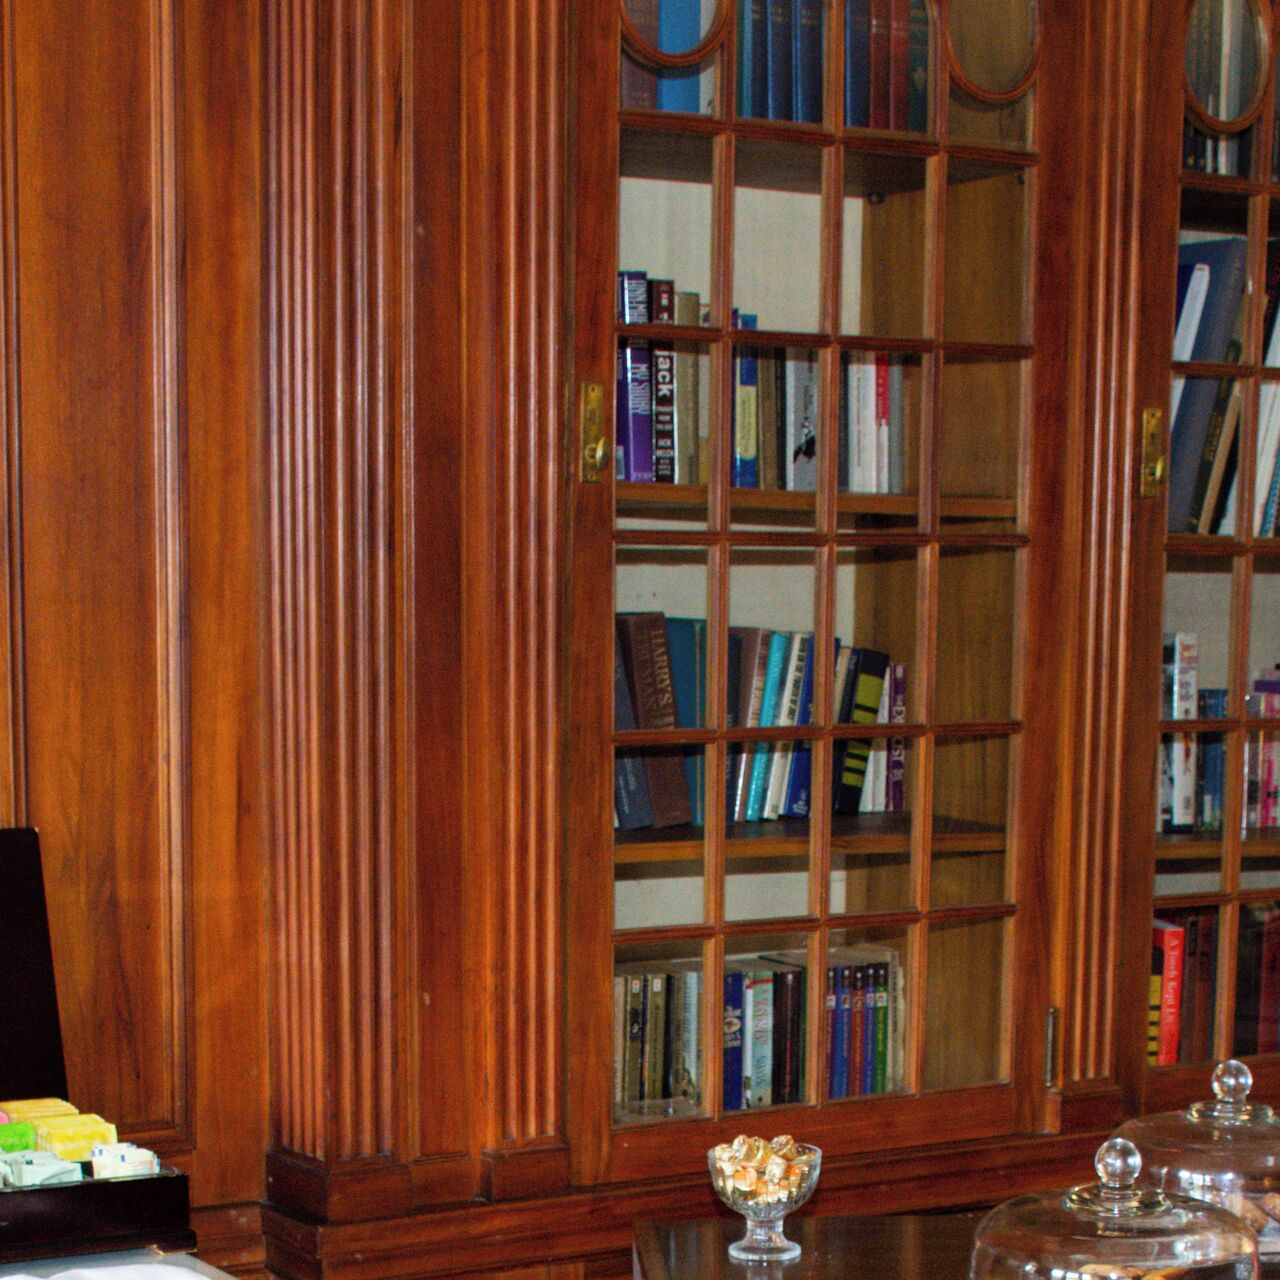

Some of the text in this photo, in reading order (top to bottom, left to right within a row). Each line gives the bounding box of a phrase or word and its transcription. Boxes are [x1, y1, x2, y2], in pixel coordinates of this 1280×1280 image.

[655, 350, 674, 398] jack
[630, 382, 650, 415] STORY
[650, 629, 671, 692] HARRY
